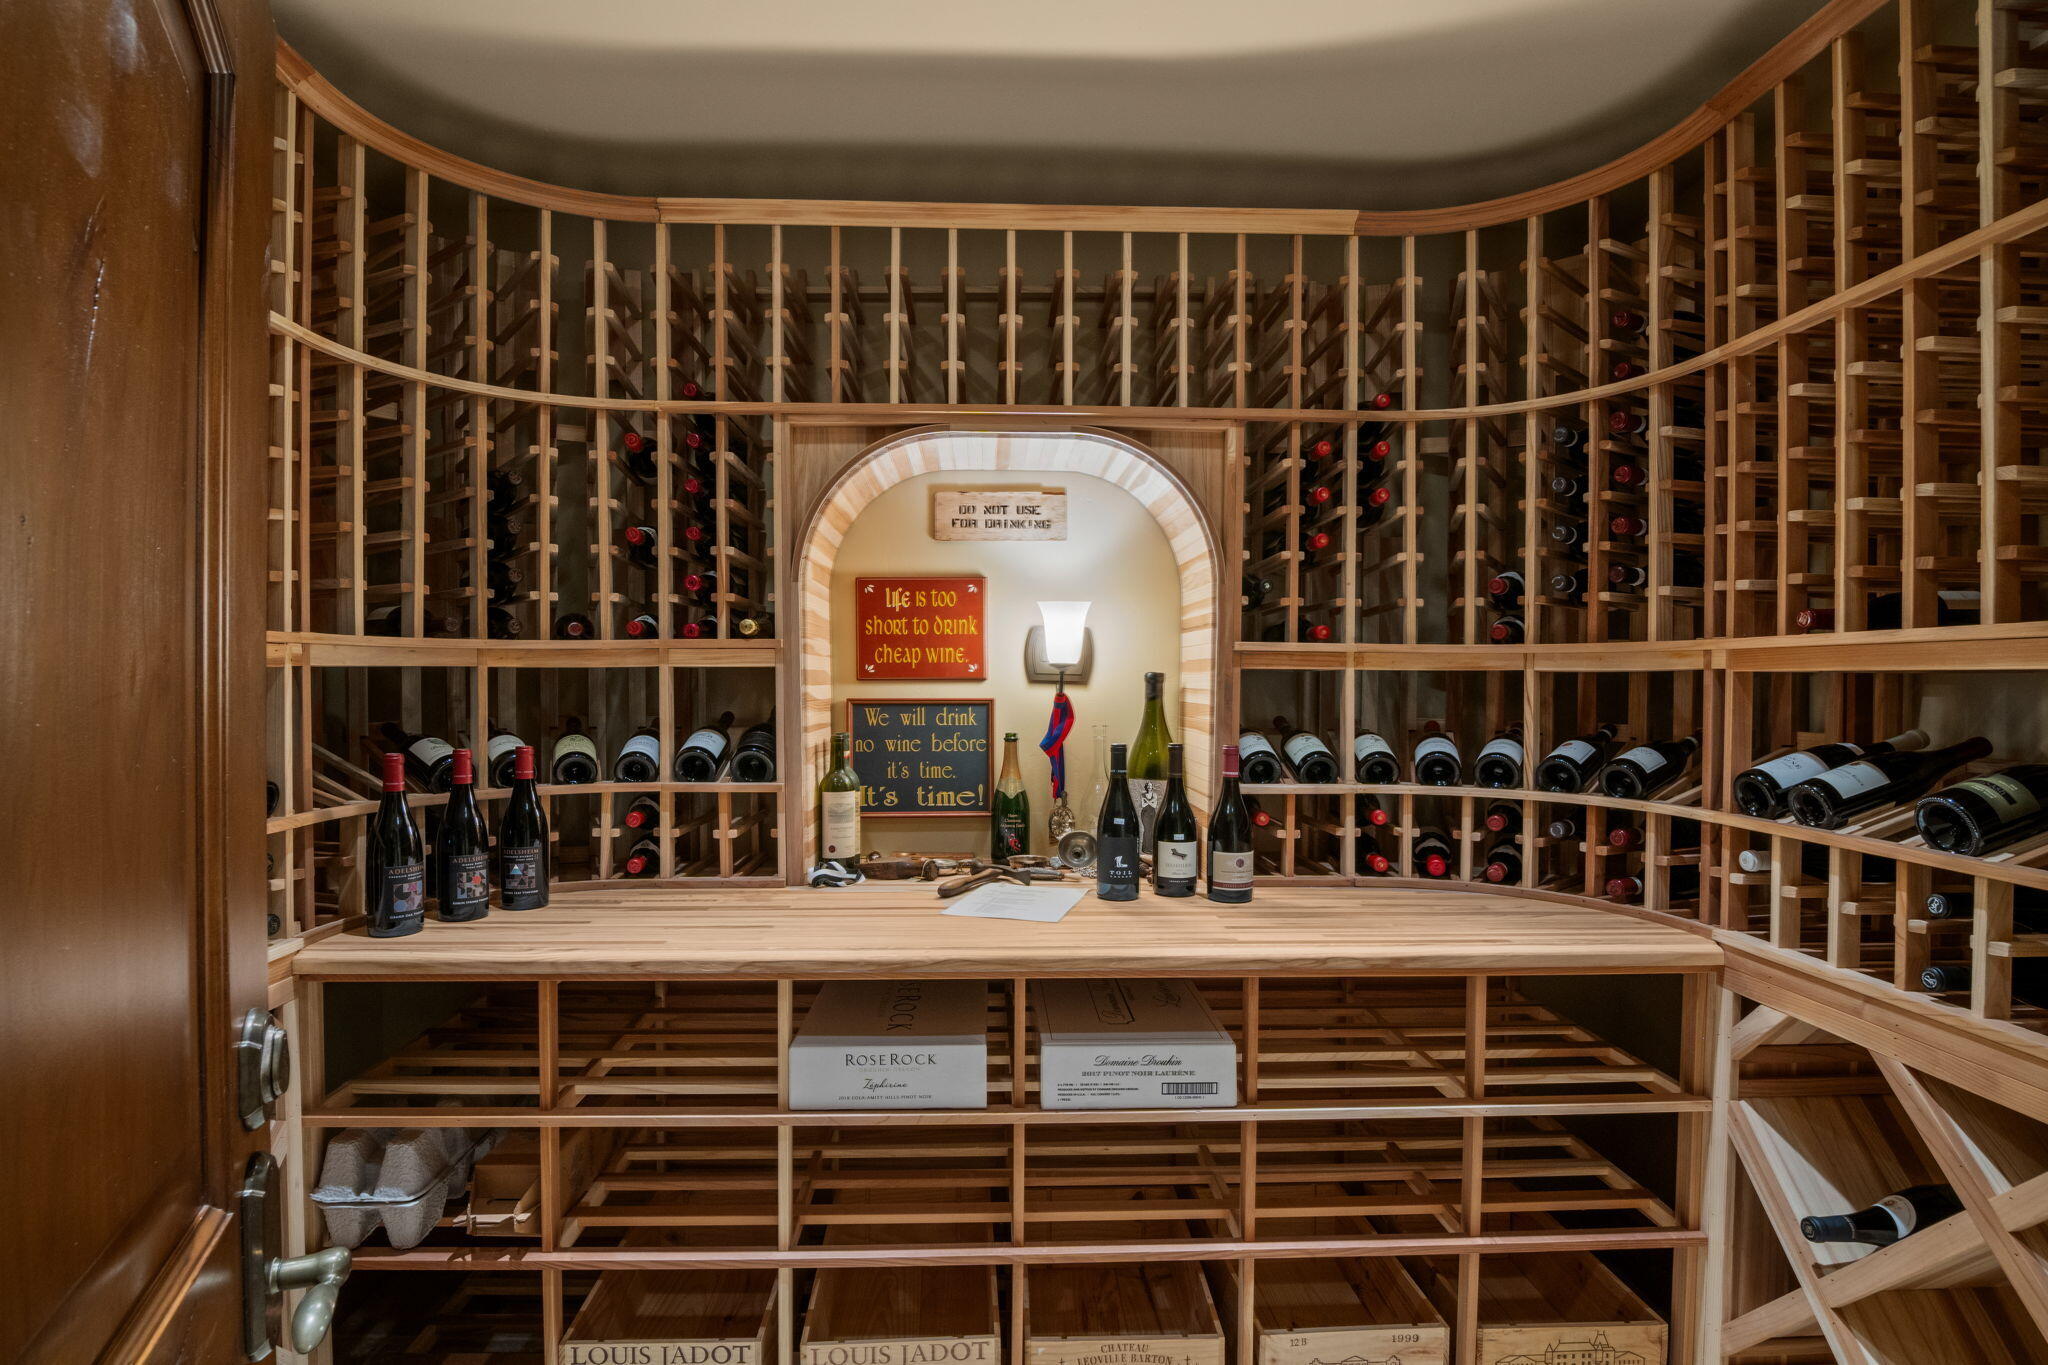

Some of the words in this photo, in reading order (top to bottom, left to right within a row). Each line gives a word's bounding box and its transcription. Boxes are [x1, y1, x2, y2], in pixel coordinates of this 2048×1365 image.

[958, 505, 977, 515] DO
[983, 505, 1009, 515] NOT
[1016, 505, 1042, 515] USE
[951, 518, 979, 529] FOR
[984, 519, 1053, 529] DRINKING
[930, 589, 957, 607] too
[865, 615, 908, 635] short
[912, 617, 929, 635] to
[933, 615, 978, 635] drink
[874, 643, 921, 669] cheap
[925, 647, 969, 663] wine.
[864, 706, 889, 726] We
[900, 706, 926, 726] will
[935, 706, 977, 726] drink
[855, 738, 875, 752] no
[885, 734, 921, 752] wine
[931, 732, 987, 752] before
[919, 761, 956, 779] time.
[917, 783, 984, 806] time!
[845, 1053, 937, 1066] ROSEROCK
[1093, 1055, 1139, 1067] Domaine
[1140, 1054, 1183, 1067] Drouhin
[1391, 1334, 1419, 1343] 1999
[570, 1346, 651, 1365] LOUIS
[660, 1345, 751, 1365] JADOT
[810, 1345, 891, 1365] LOUIS
[900, 1341, 990, 1365] JADOT
[1100, 1343, 1149, 1353] CHATEAU
[1130, 1353, 1173, 1365] BARTON
